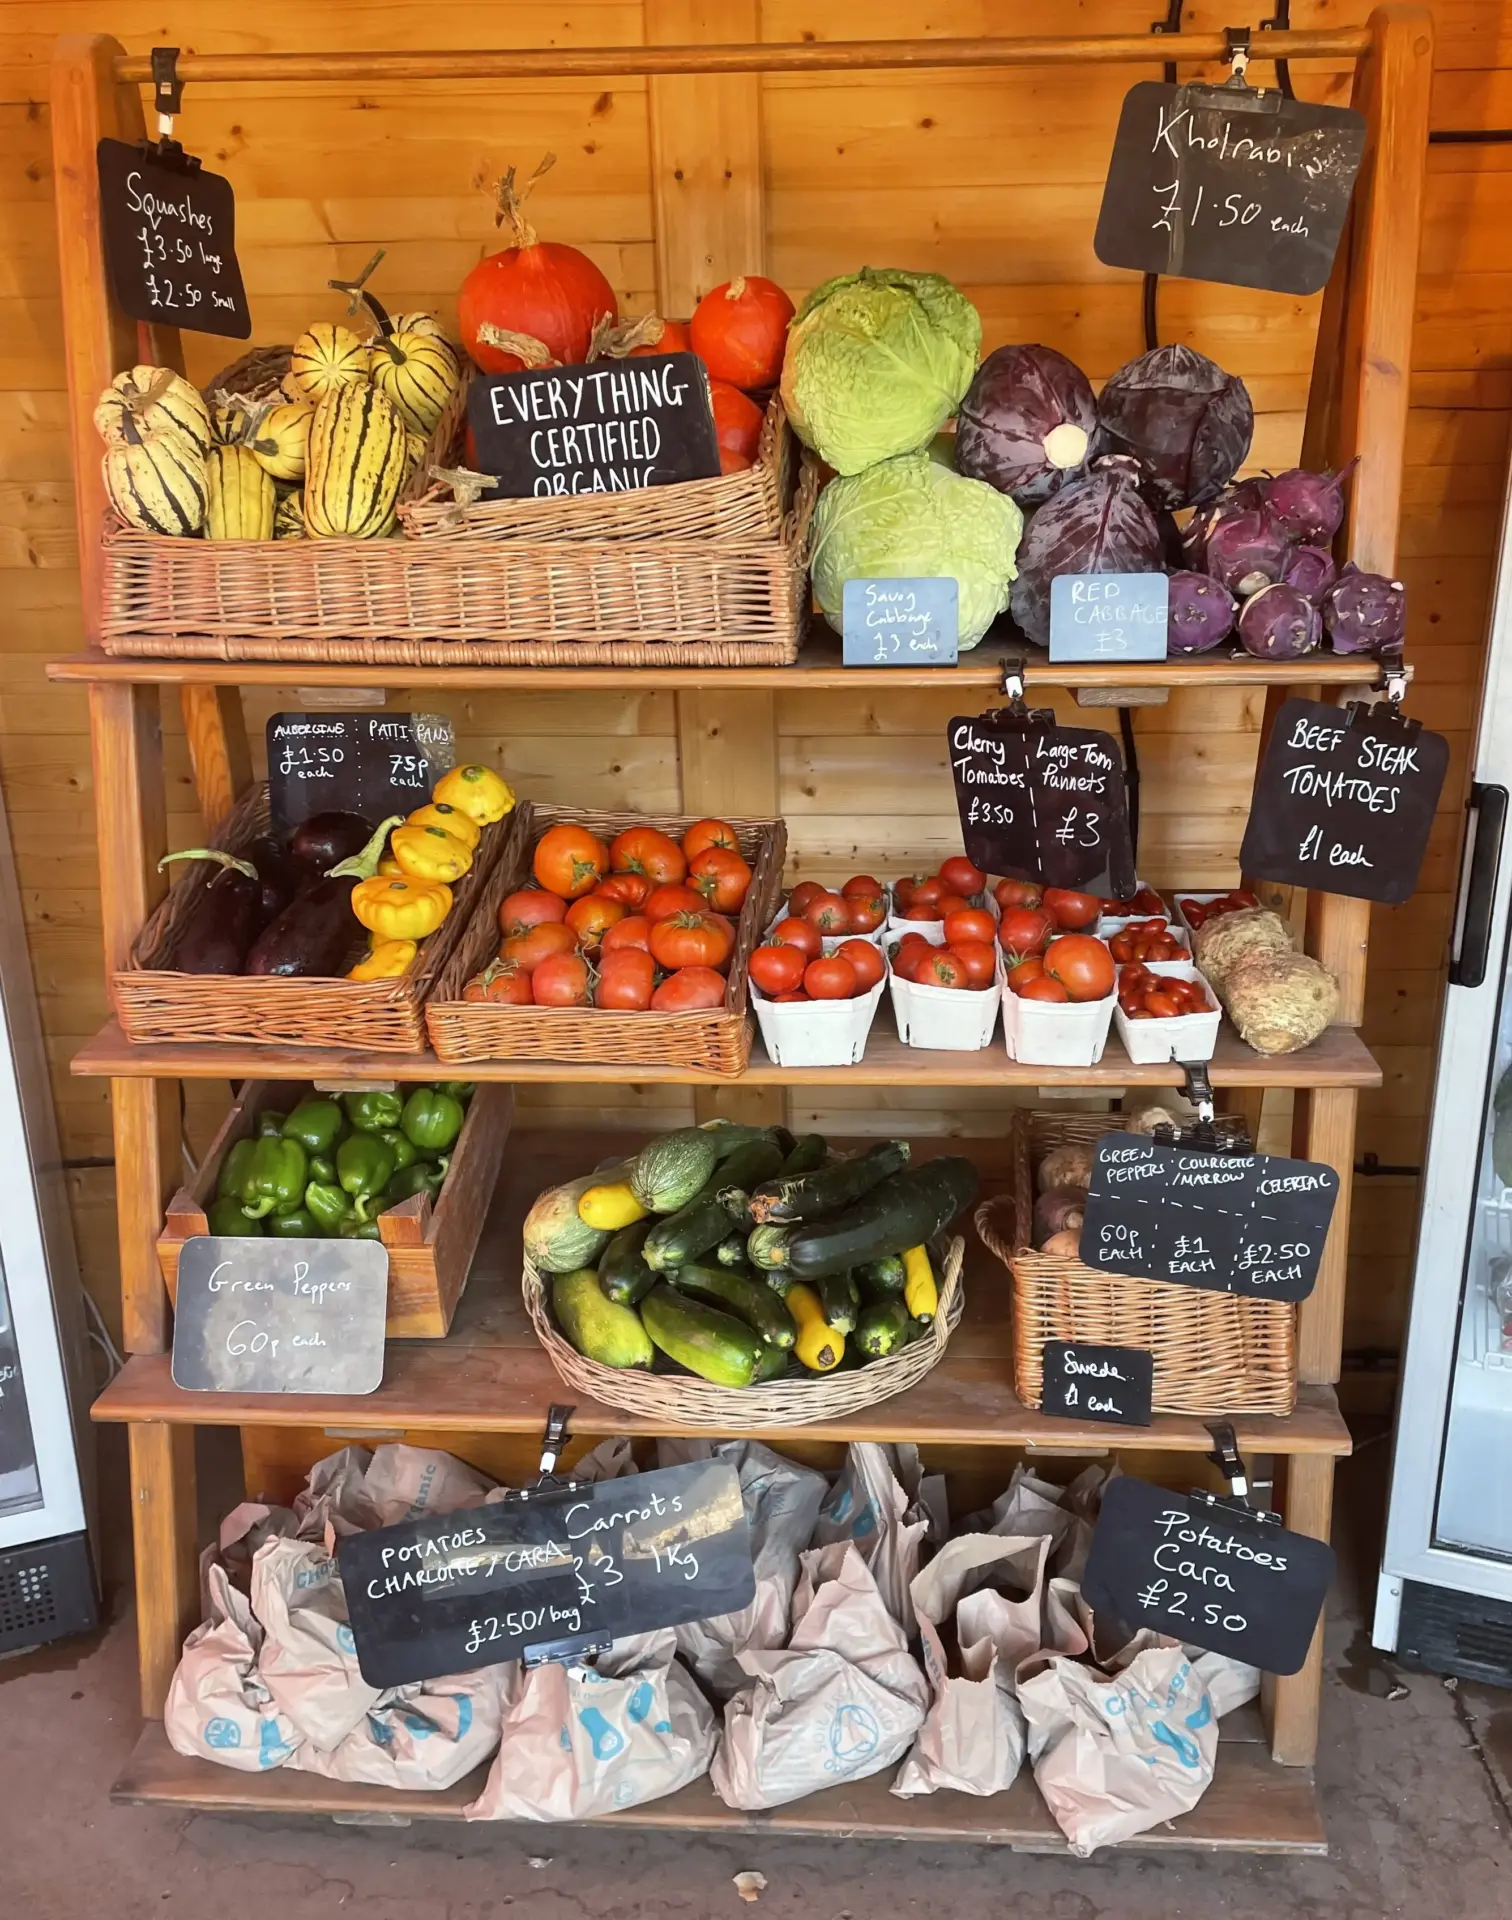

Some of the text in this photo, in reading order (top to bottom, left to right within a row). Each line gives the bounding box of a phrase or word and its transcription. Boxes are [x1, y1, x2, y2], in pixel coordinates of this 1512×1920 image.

[126, 171, 213, 236] Squashes
[1270, 215, 1309, 238] each
[489, 363, 689, 426] EVERYTHING
[530, 416, 661, 469] CERTIFIED
[865, 583, 916, 613] Savoy
[1071, 580, 1121, 605] RED
[1074, 603, 1169, 624] CABBAGE
[1093, 627, 1128, 653] £3
[274, 722, 346, 738] AUBERGINE
[953, 724, 1006, 767] Cherry
[1035, 735, 1079, 769] Large
[1286, 717, 1421, 775] BEEF STEAK
[297, 765, 335, 779] each
[389, 775, 425, 788] each
[953, 755, 1026, 789] Tomatoes
[1282, 764, 1401, 815] TOMATOES
[967, 796, 1014, 826] £3.50
[1055, 806, 1101, 848] £3
[1298, 824, 1375, 868] £1 each
[1099, 1146, 1154, 1163] GREEN
[1178, 1156, 1256, 1171] COURGETTE
[1106, 1162, 1166, 1185] PEPPERS
[1259, 1172, 1333, 1196] CELERIAC
[1098, 1246, 1144, 1263] EACH
[1173, 1234, 1210, 1258] £1
[1168, 1257, 1217, 1274] EACH
[1251, 1263, 1303, 1285] EACH
[207, 1260, 353, 1305] Green Peppers
[291, 1331, 327, 1348] each
[1063, 1350, 1127, 1382] Swede
[565, 1492, 683, 1540] Carrots
[381, 1526, 487, 1569] POTATOES
[1153, 1509, 1289, 1572] Potatoes
[366, 1560, 478, 1599] CHARLOTTE
[1153, 1543, 1236, 1593] Cara
[1136, 1578, 1248, 1632] £2.50
